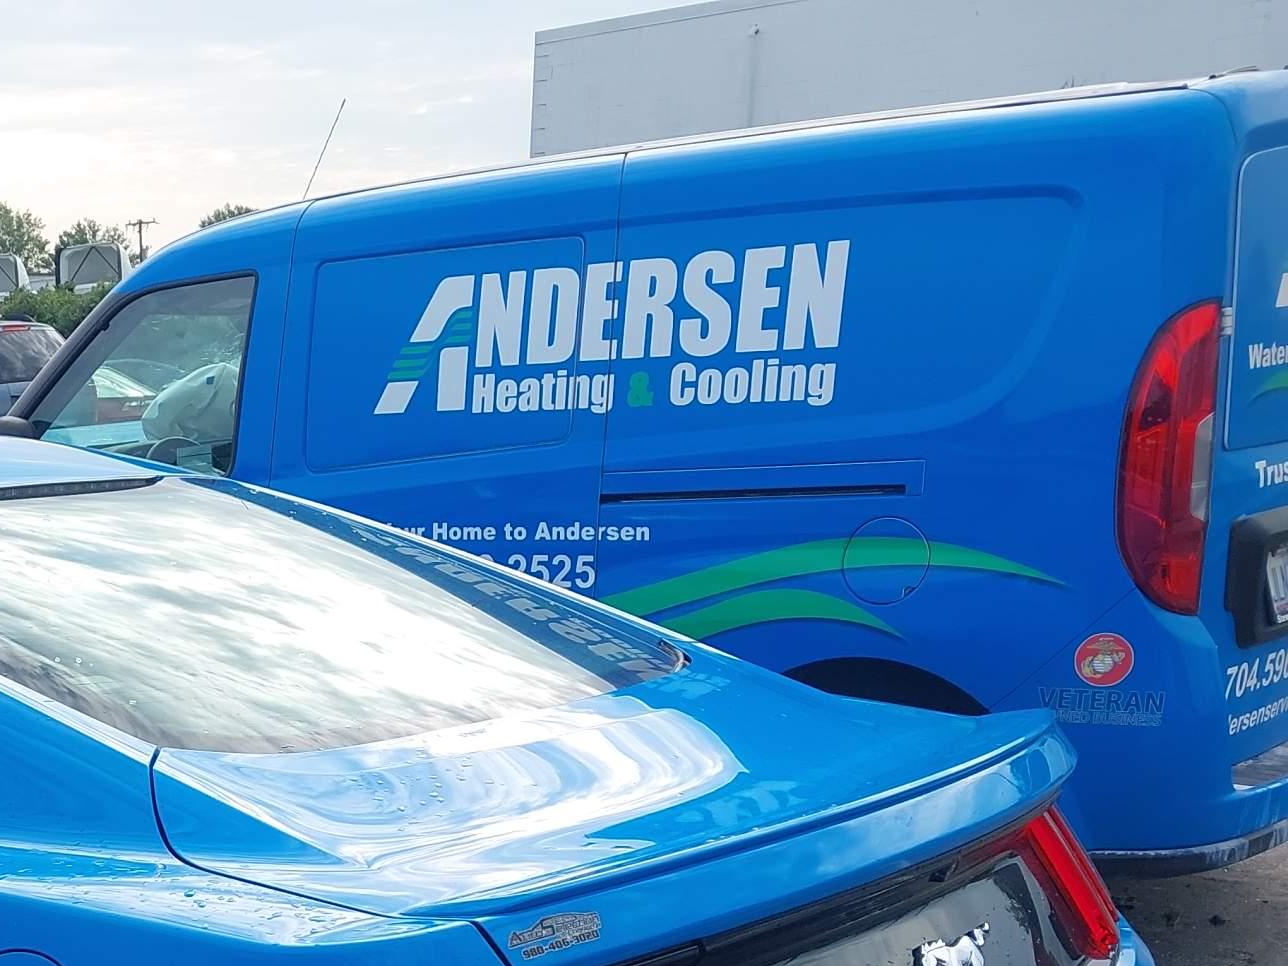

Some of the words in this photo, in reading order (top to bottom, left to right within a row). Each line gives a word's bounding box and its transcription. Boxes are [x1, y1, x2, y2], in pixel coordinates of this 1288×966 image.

[374, 239, 850, 415] ANDERSEN
[471, 369, 615, 413] Heating
[627, 371, 654, 407] &
[669, 358, 836, 407] Cooling
[432, 522, 496, 540] Home
[504, 523, 527, 541] to
[534, 522, 650, 541] Andersen
[1038, 687, 1166, 714] VETERAN
